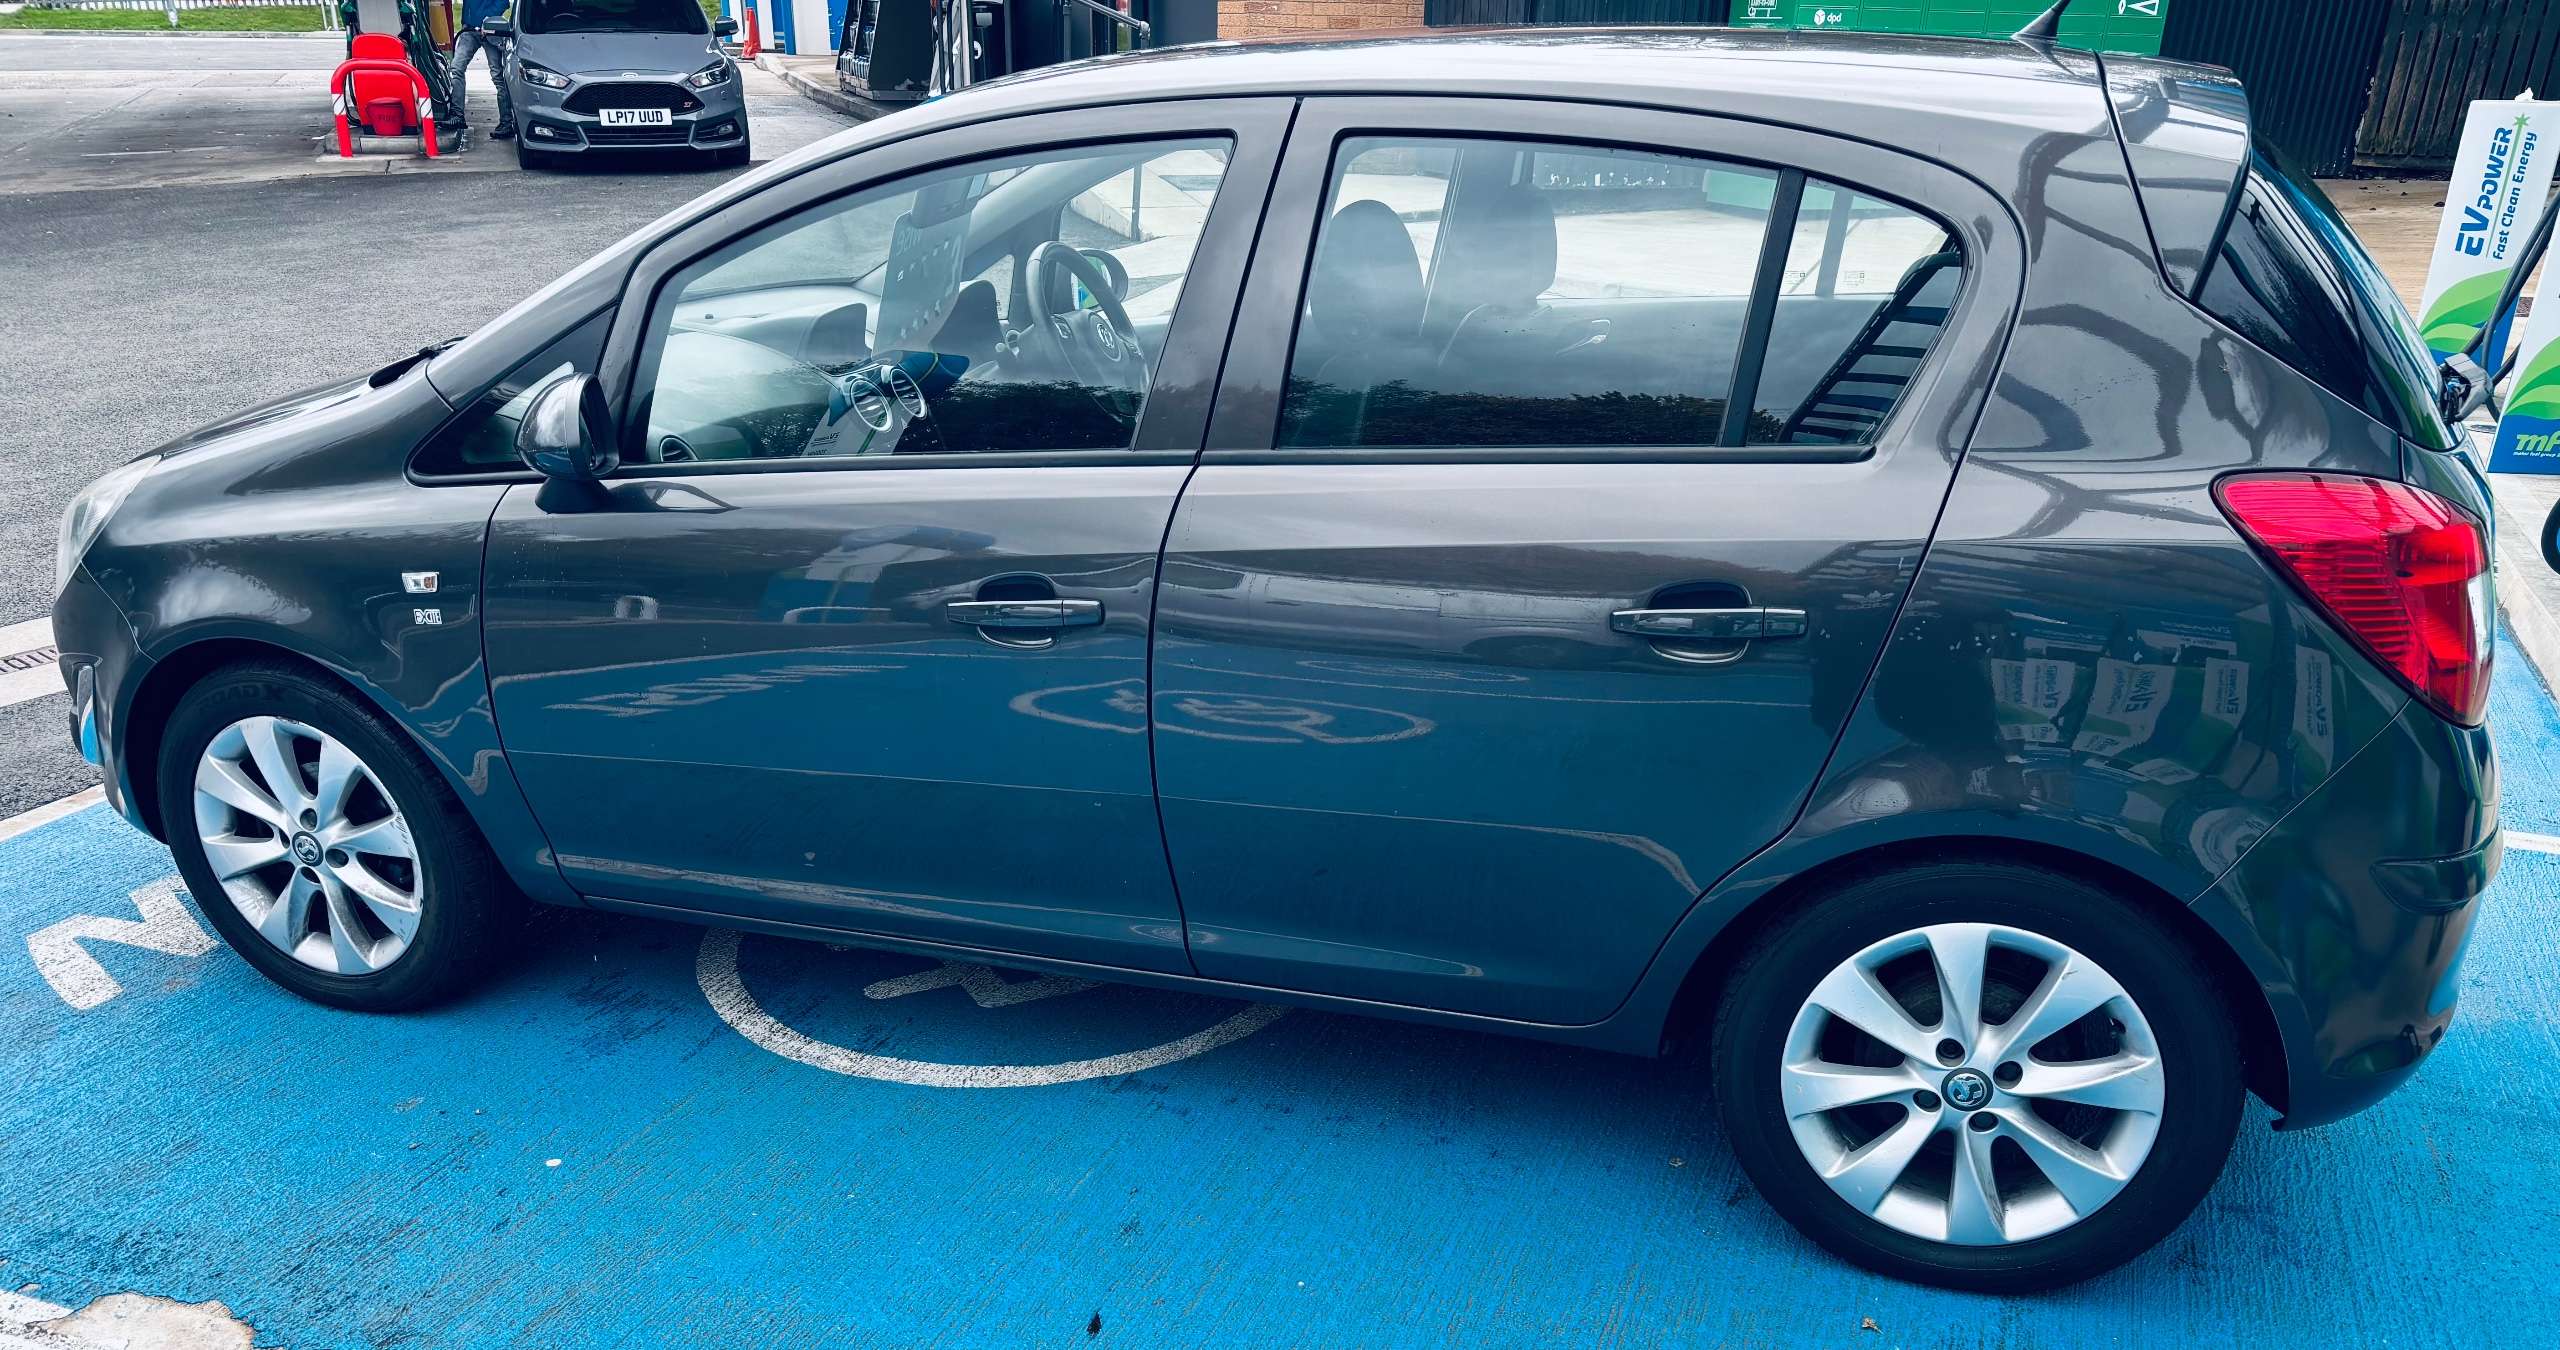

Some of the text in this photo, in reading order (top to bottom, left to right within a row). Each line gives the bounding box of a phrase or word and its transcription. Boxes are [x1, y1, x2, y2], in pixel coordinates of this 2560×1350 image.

[1826, 12, 1842, 24] dpd
[607, 109, 663, 123] LP17 UUD
[2455, 127, 2513, 256] EV POWER
[2493, 132, 2538, 260] Fast Clean Energy
[413, 608, 443, 625] EXCITE
